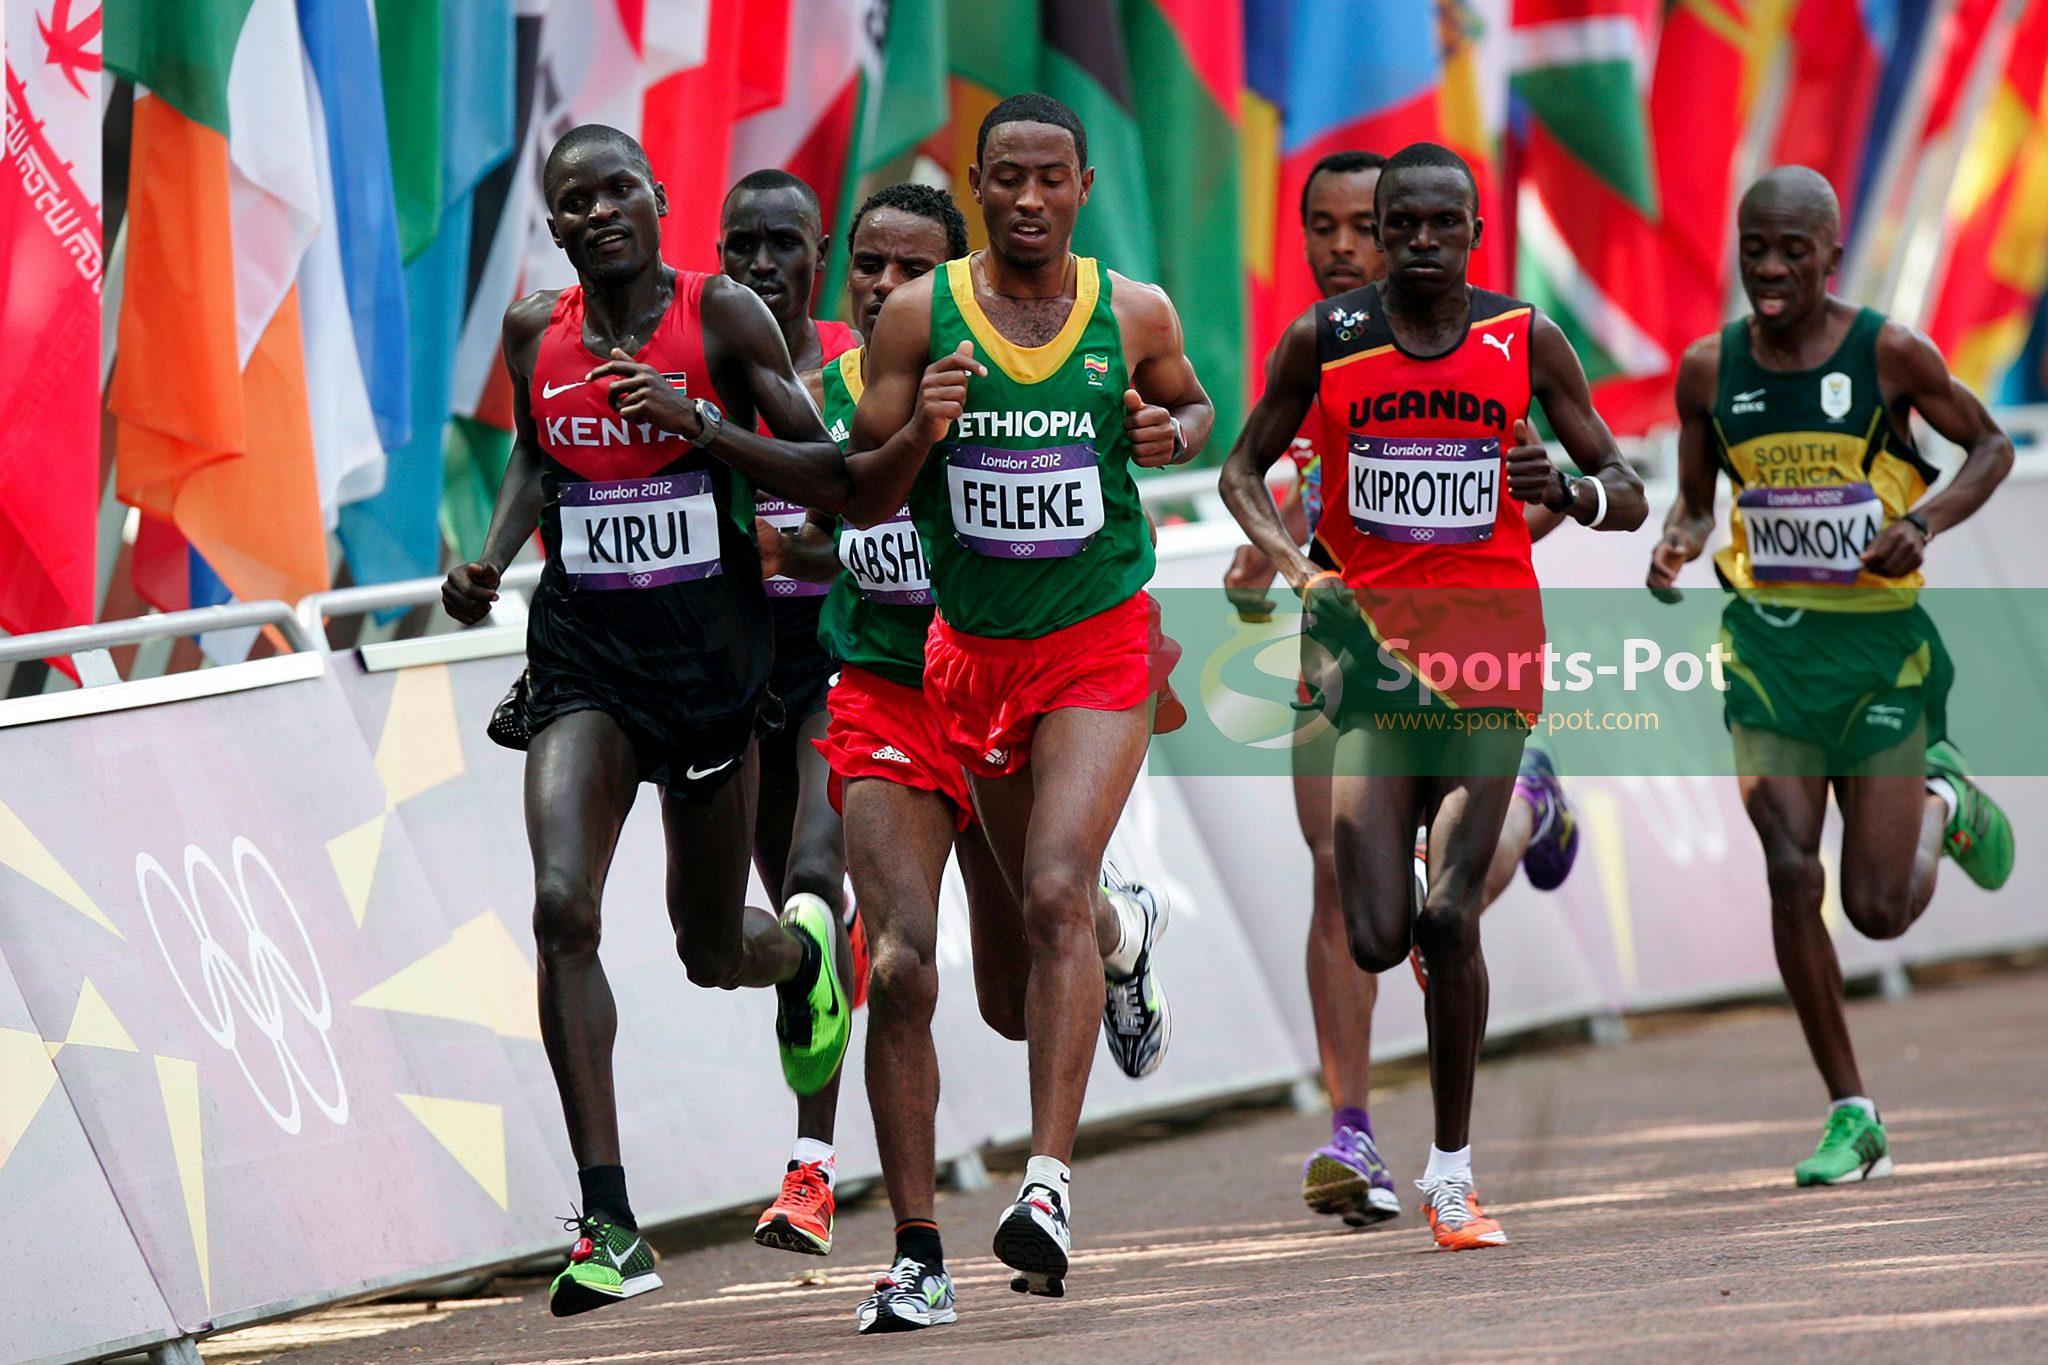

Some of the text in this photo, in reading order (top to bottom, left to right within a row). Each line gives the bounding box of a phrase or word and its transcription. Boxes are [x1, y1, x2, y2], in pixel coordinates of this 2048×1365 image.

[1350, 389, 1506, 431] UGANDA
[958, 410, 1096, 439] ETHIOPIA
[981, 452, 1061, 470] London 2012
[1383, 443, 1467, 457] London 2012
[1754, 444, 1837, 466] SOUTH
[1756, 466, 1843, 487] AFRICA
[589, 481, 672, 501] London 2012
[1354, 465, 1494, 517] KIPROTICH
[1767, 492, 1812, 506] London
[963, 480, 1085, 530] FELEKE
[585, 510, 690, 564] KIRUI
[1750, 514, 1878, 560] MOKOKA
